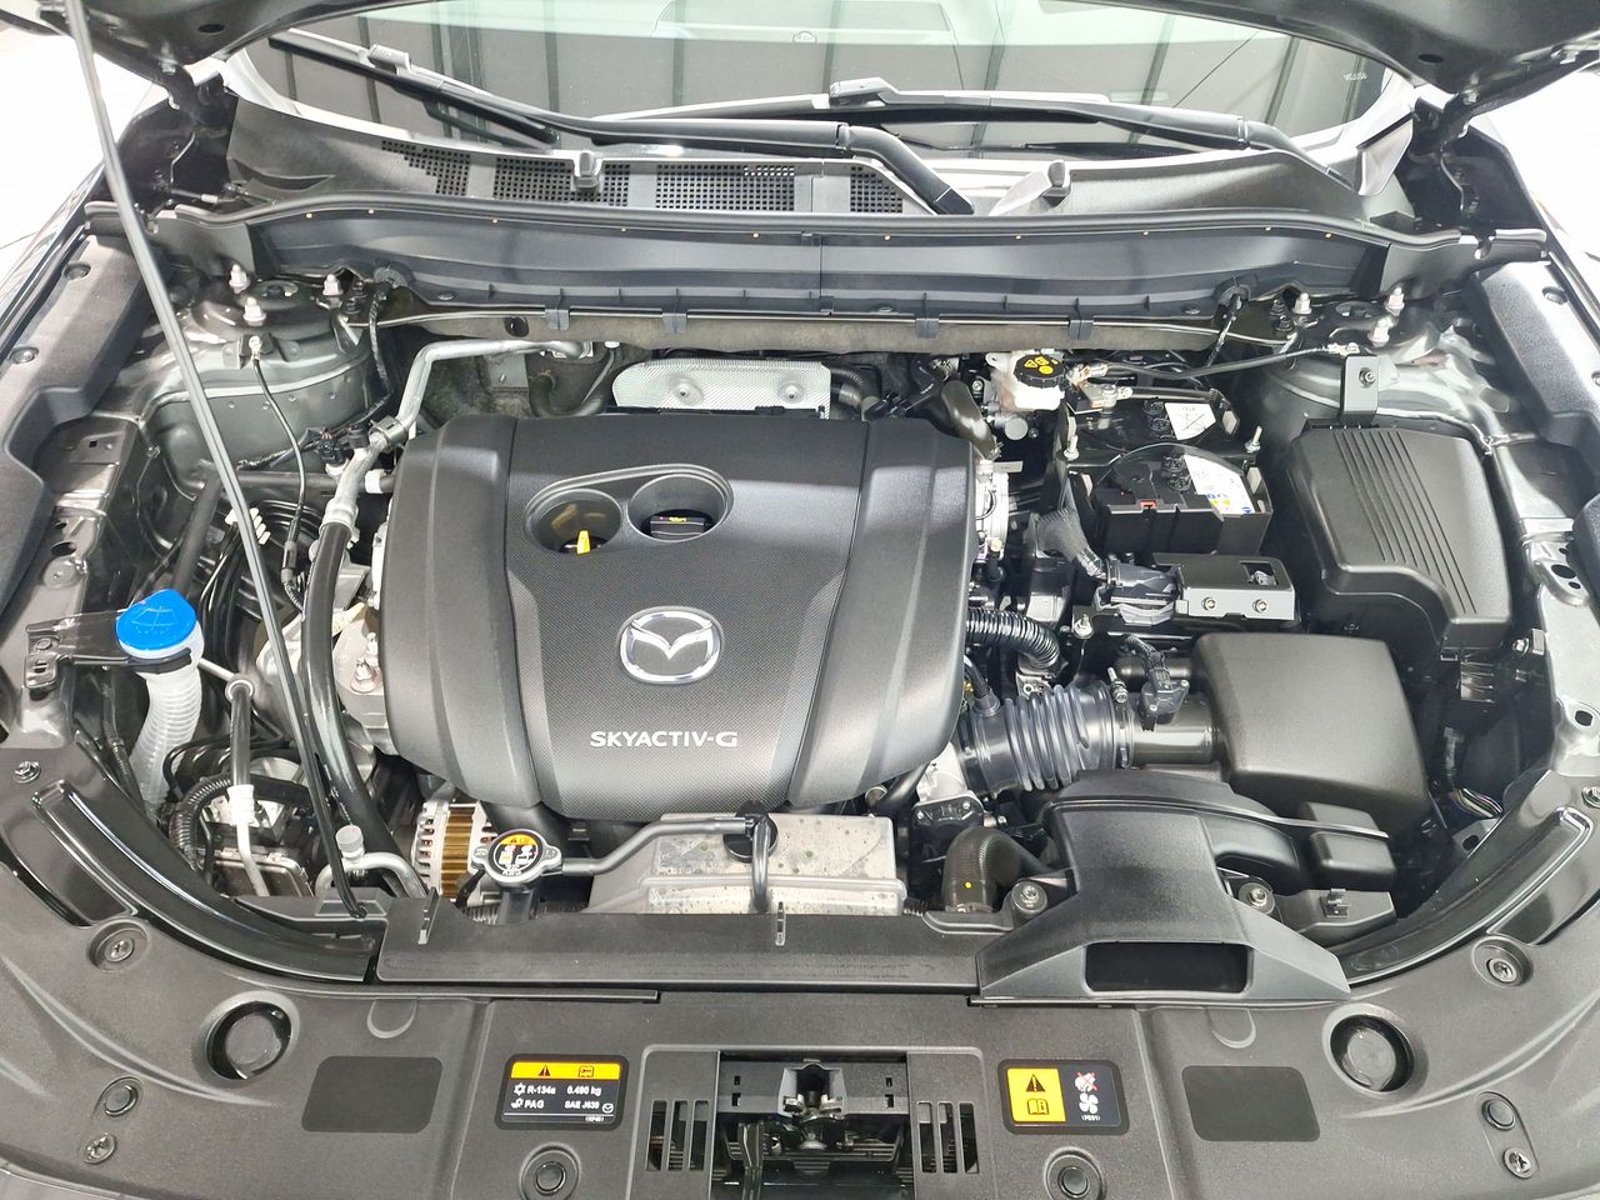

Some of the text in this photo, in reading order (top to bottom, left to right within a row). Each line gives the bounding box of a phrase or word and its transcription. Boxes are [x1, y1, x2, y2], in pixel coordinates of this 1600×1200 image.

[590, 731, 738, 747] SKYACTIV-G
[591, 1086, 602, 1097] kg
[524, 1099, 545, 1109] PAG
[564, 1101, 581, 1110] SAE
